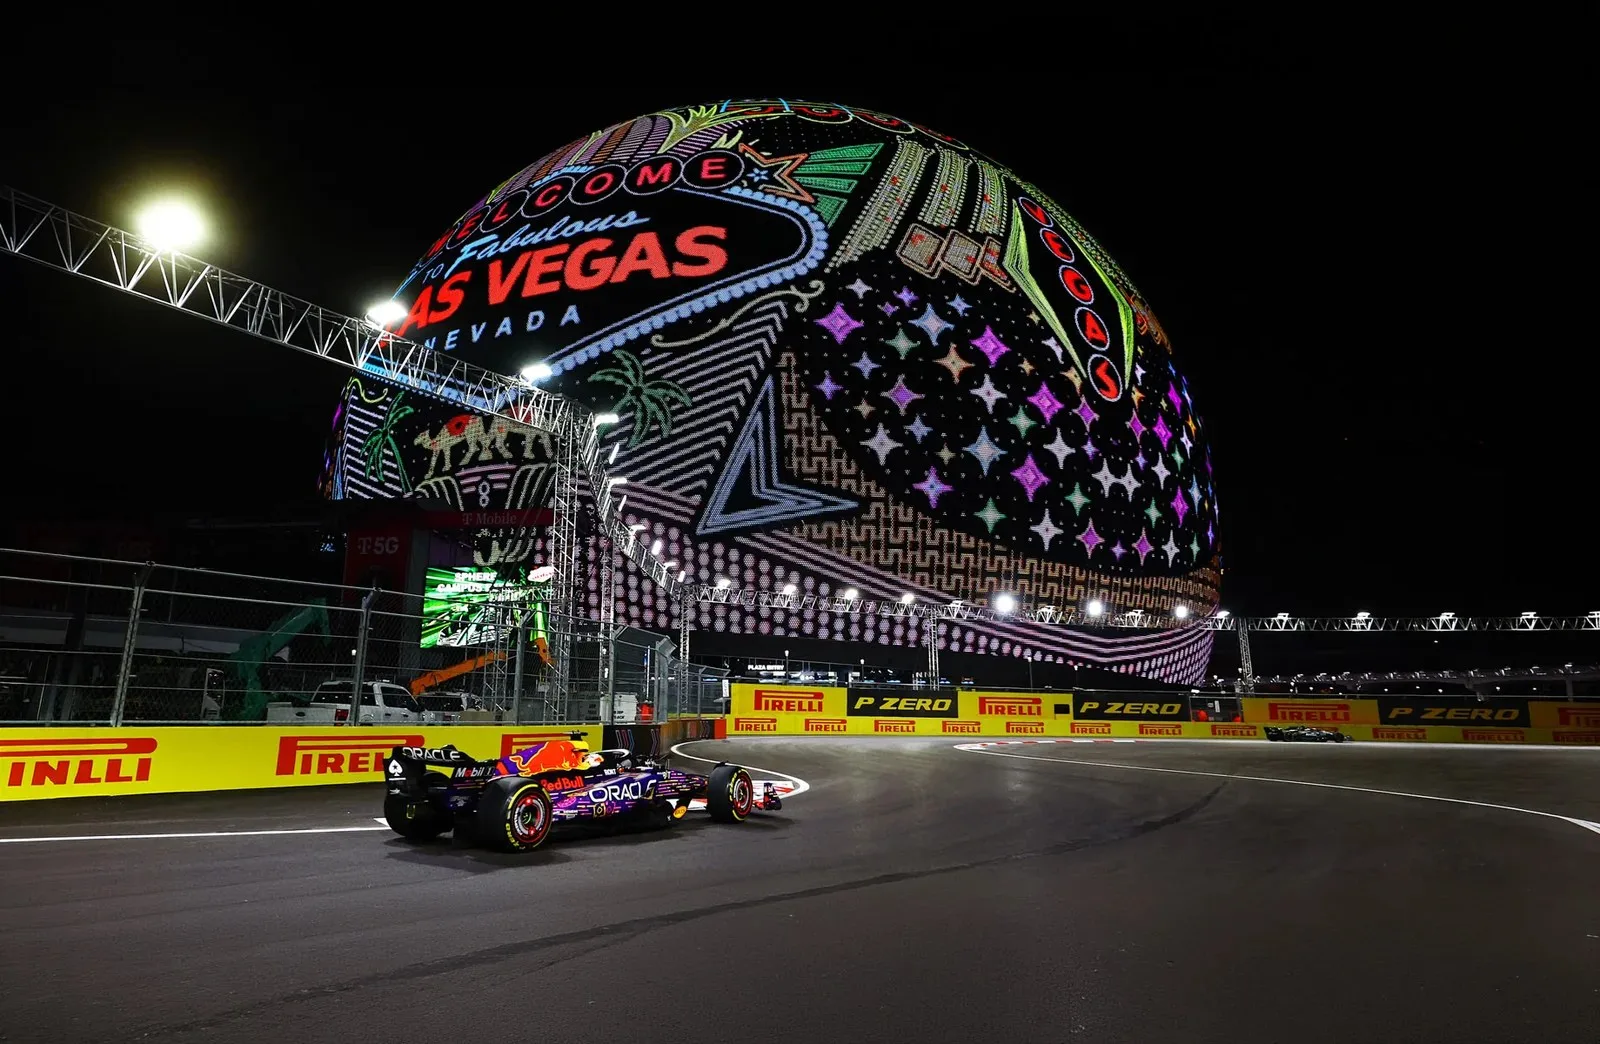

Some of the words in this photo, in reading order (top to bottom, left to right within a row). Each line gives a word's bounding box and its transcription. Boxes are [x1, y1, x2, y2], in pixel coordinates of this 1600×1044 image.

[427, 158, 728, 258] WELCOME
[423, 263, 445, 284] TO
[444, 211, 651, 279] Fabulous
[380, 270, 473, 349] AS
[488, 225, 729, 306] VEGAS
[424, 304, 583, 351] NEVADA
[476, 511, 517, 526] Mobile
[373, 537, 400, 555] 5G
[454, 572, 498, 582] SPHERE
[754, 689, 824, 713] PIRELLI
[854, 696, 876, 709] P
[879, 697, 952, 712] ZERO
[978, 696, 1042, 716] PIRELLI
[1080, 702, 1099, 714] P
[1103, 702, 1182, 715] ZERO
[1268, 703, 1351, 721] PIRELLI
[1388, 707, 1414, 719] P
[1420, 708, 1520, 721] ZERO
[735, 717, 777, 732] PIRELLI
[805, 718, 847, 733] PIRELLI
[874, 719, 916, 733] PIRELLI
[942, 720, 981, 734] PIRELLI
[1006, 721, 1045, 734] PIRELLI
[1070, 722, 1111, 735] PIRELLI
[1138, 723, 1182, 736] PIRELLI
[1211, 724, 1257, 737] PIRELLI
[1372, 727, 1426, 740] PIRELLI
[276, 735, 425, 776] PIREL
[402, 747, 461, 761] ORACLE
[455, 767, 484, 778] Mobil
[541, 777, 564, 791] Red
[564, 775, 585, 789] Bull
